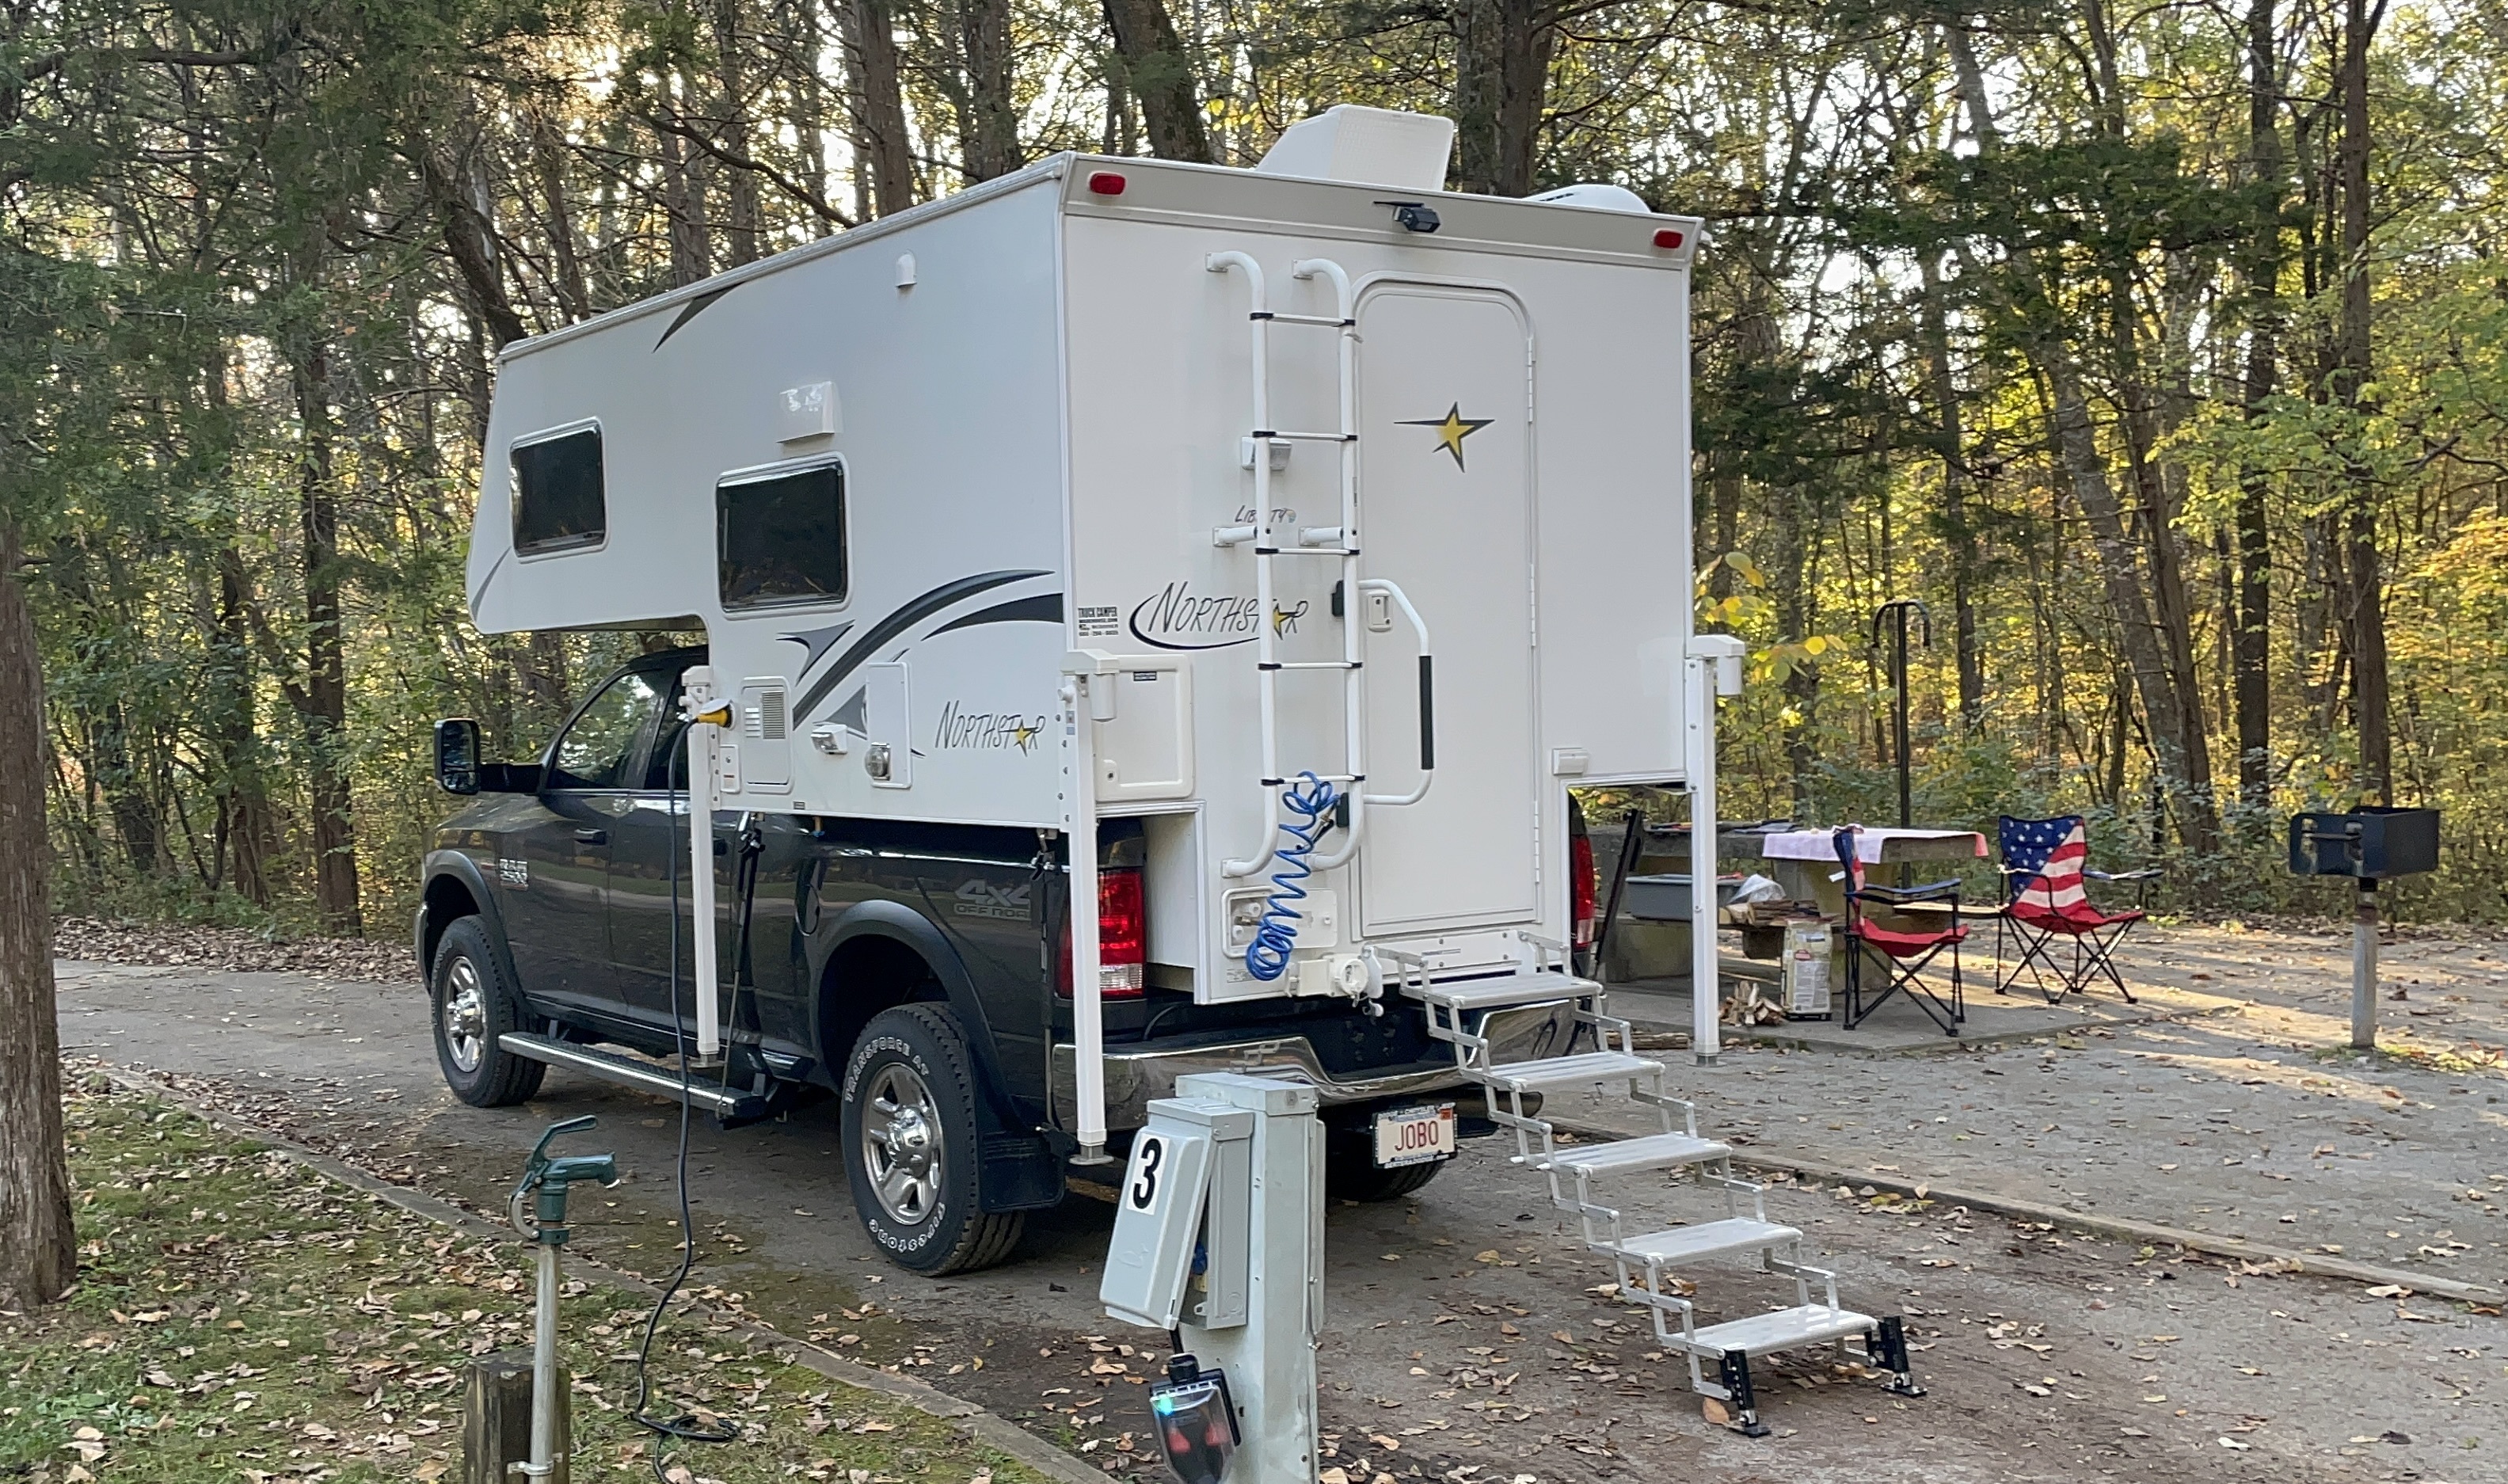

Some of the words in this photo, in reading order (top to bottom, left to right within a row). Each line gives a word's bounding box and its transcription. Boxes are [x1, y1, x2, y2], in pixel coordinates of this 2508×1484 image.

[1235, 504, 1286, 523] LIBTY
[934, 700, 1046, 757] NORTHSTAR
[956, 905, 988, 914] OFF
[991, 908, 1029, 918] ROA
[1395, 1121, 1439, 1151] JOBO
[1133, 1138, 1162, 1209] 3
